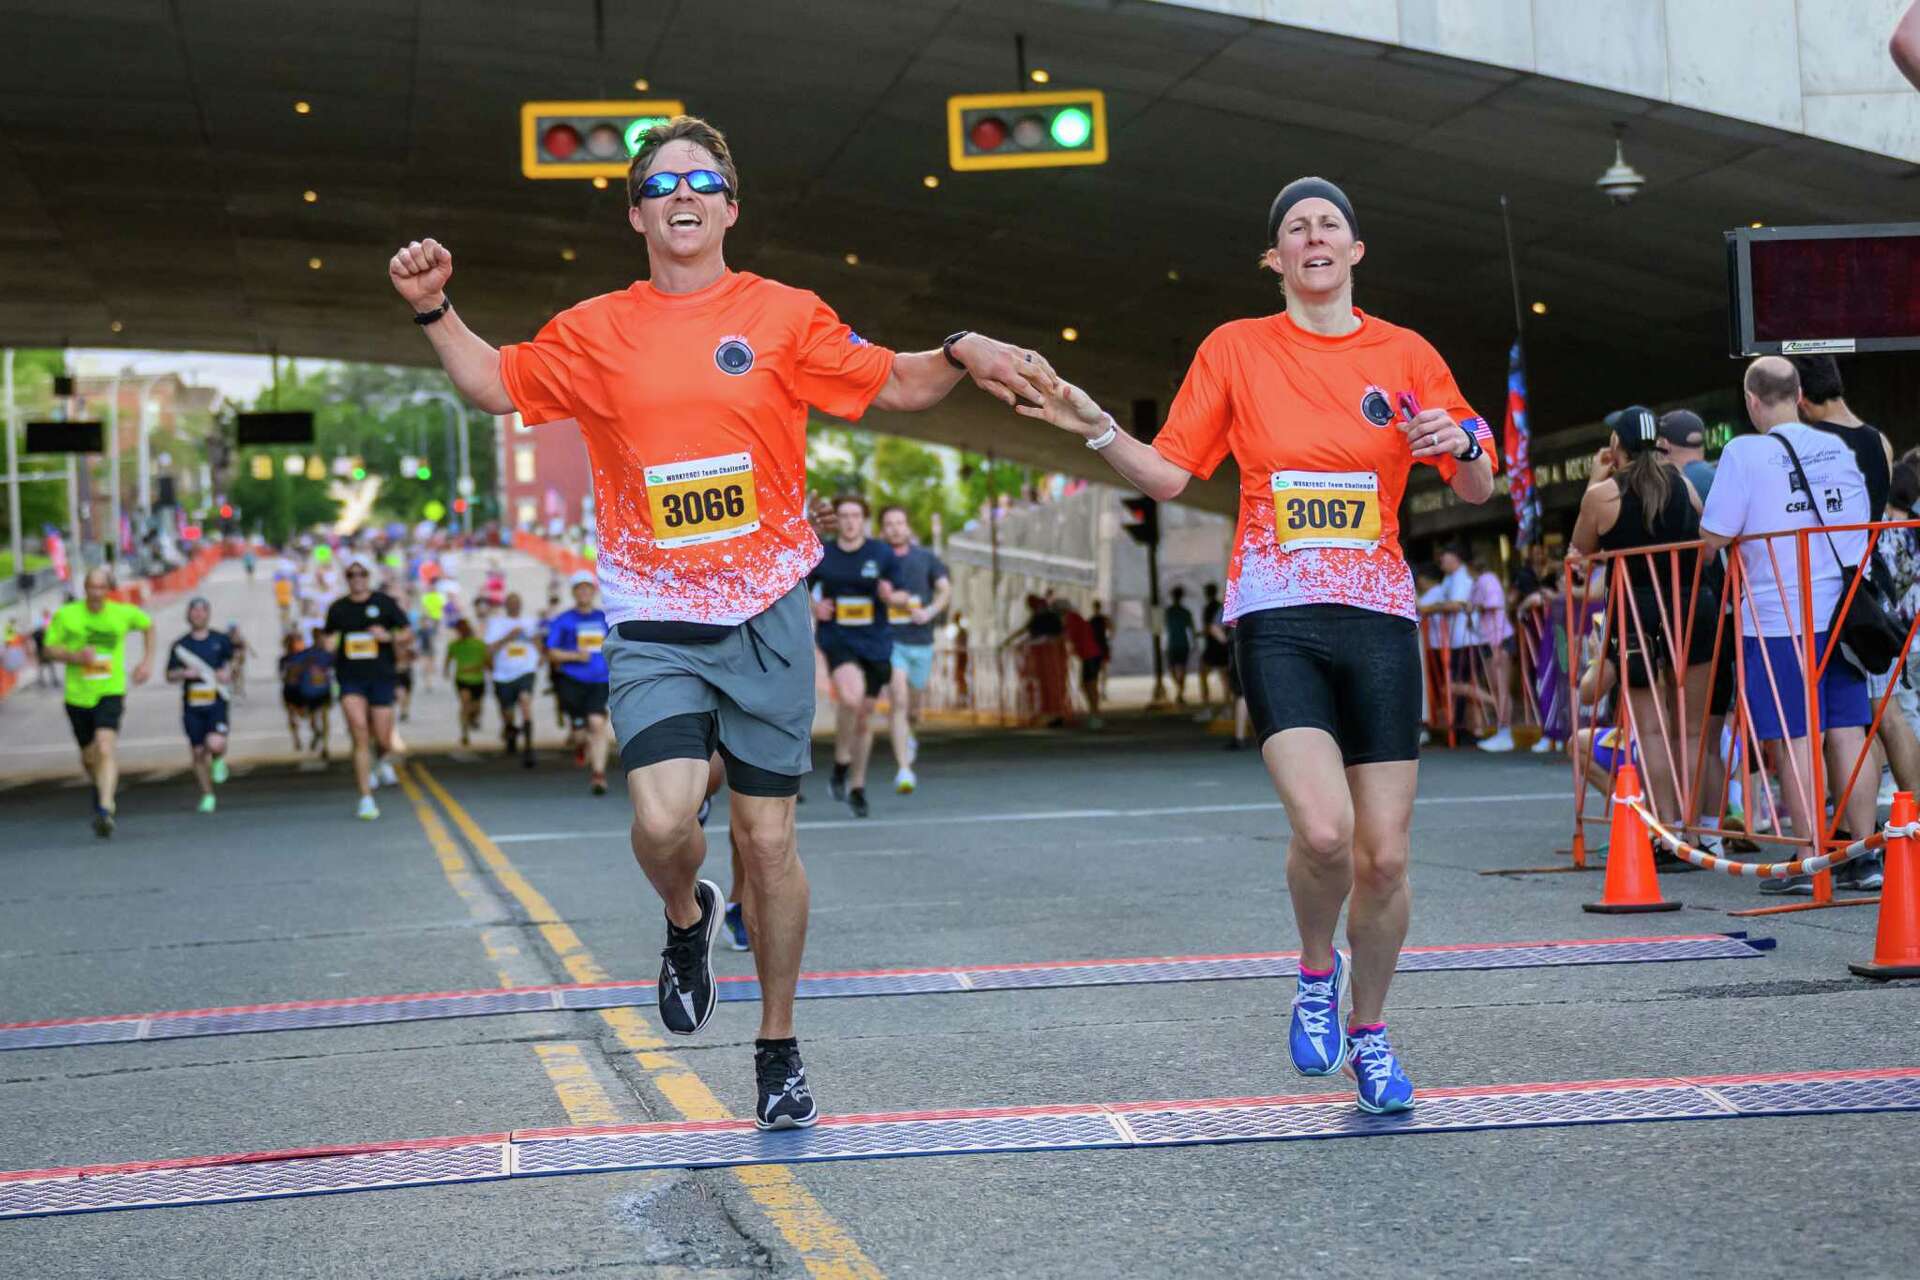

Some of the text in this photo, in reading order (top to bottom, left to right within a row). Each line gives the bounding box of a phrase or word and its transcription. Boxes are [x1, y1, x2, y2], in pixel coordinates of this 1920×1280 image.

[719, 463, 749, 474] Challenge
[1344, 482, 1374, 490] Challenge
[662, 485, 744, 528] 3066
[1286, 498, 1366, 529] 3067
